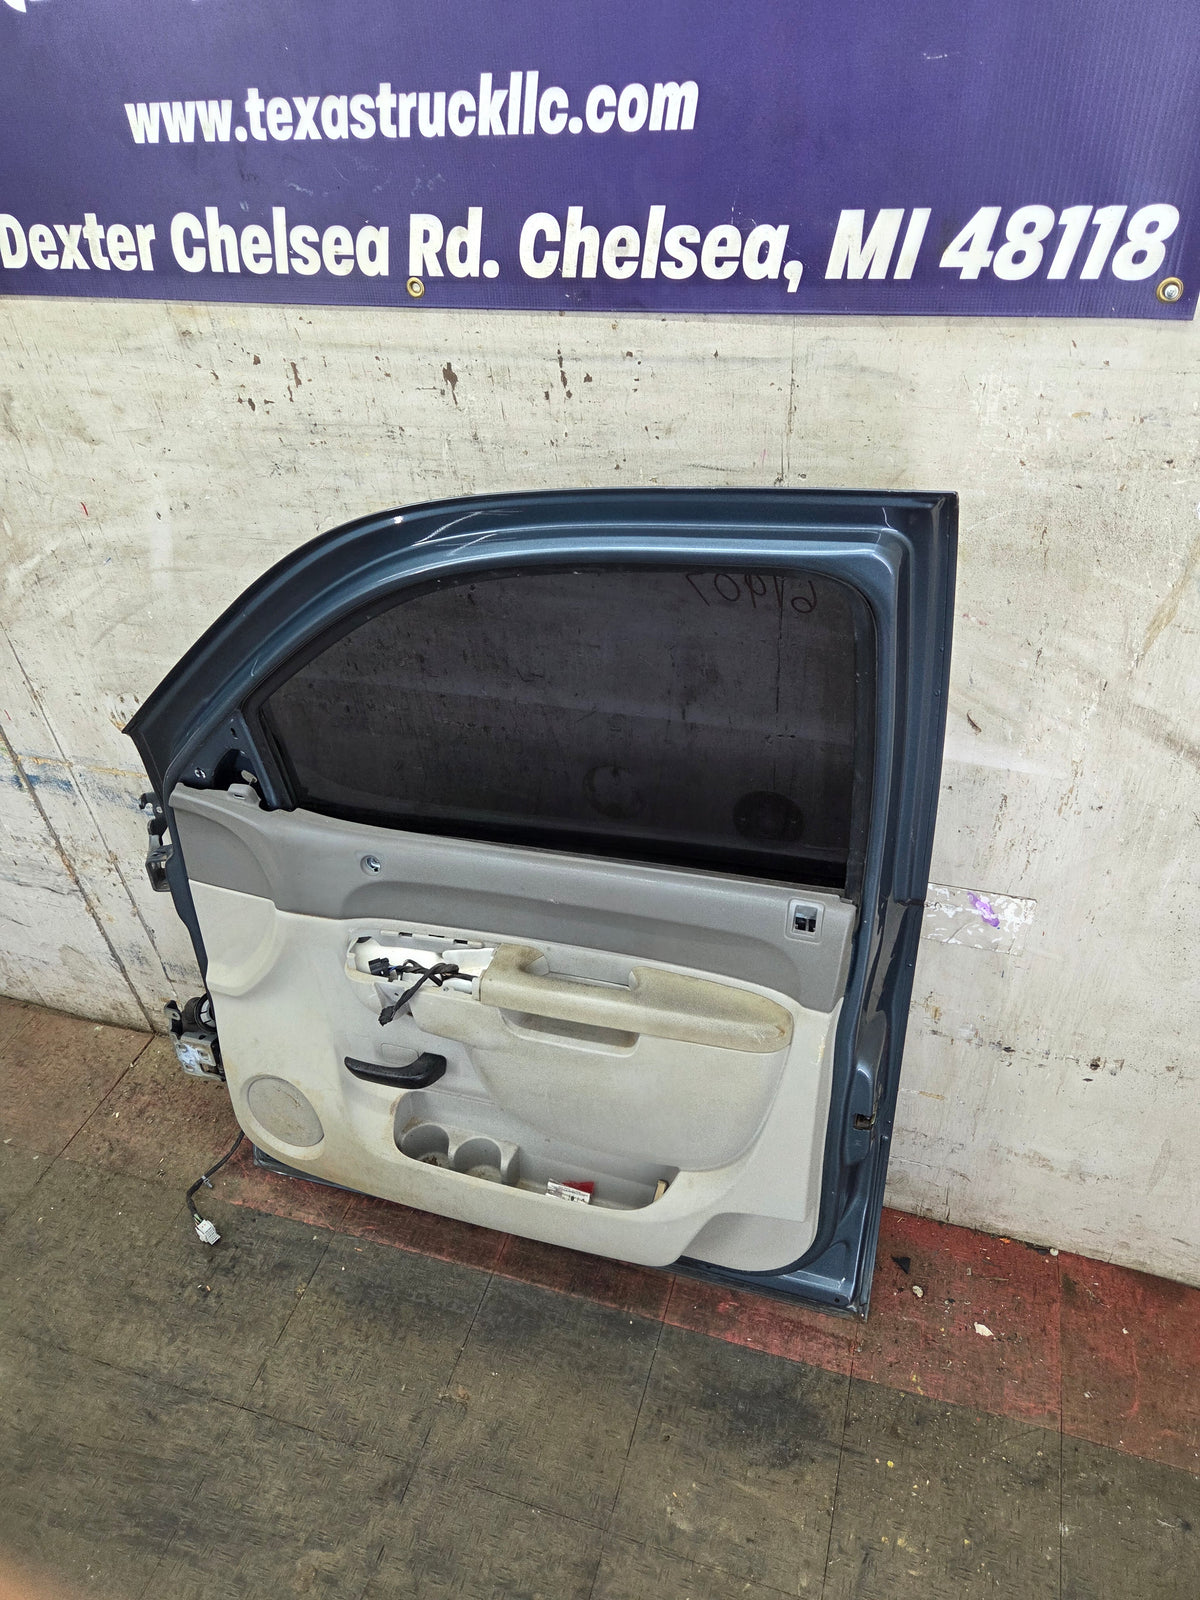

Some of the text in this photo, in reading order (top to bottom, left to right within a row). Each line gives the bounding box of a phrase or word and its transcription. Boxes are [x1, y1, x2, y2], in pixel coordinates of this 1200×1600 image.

[124, 70, 699, 144] www.texastruckllc.com
[0, 203, 1180, 292] Dexter Chelsea Rd. Chelsea, MI 48118
